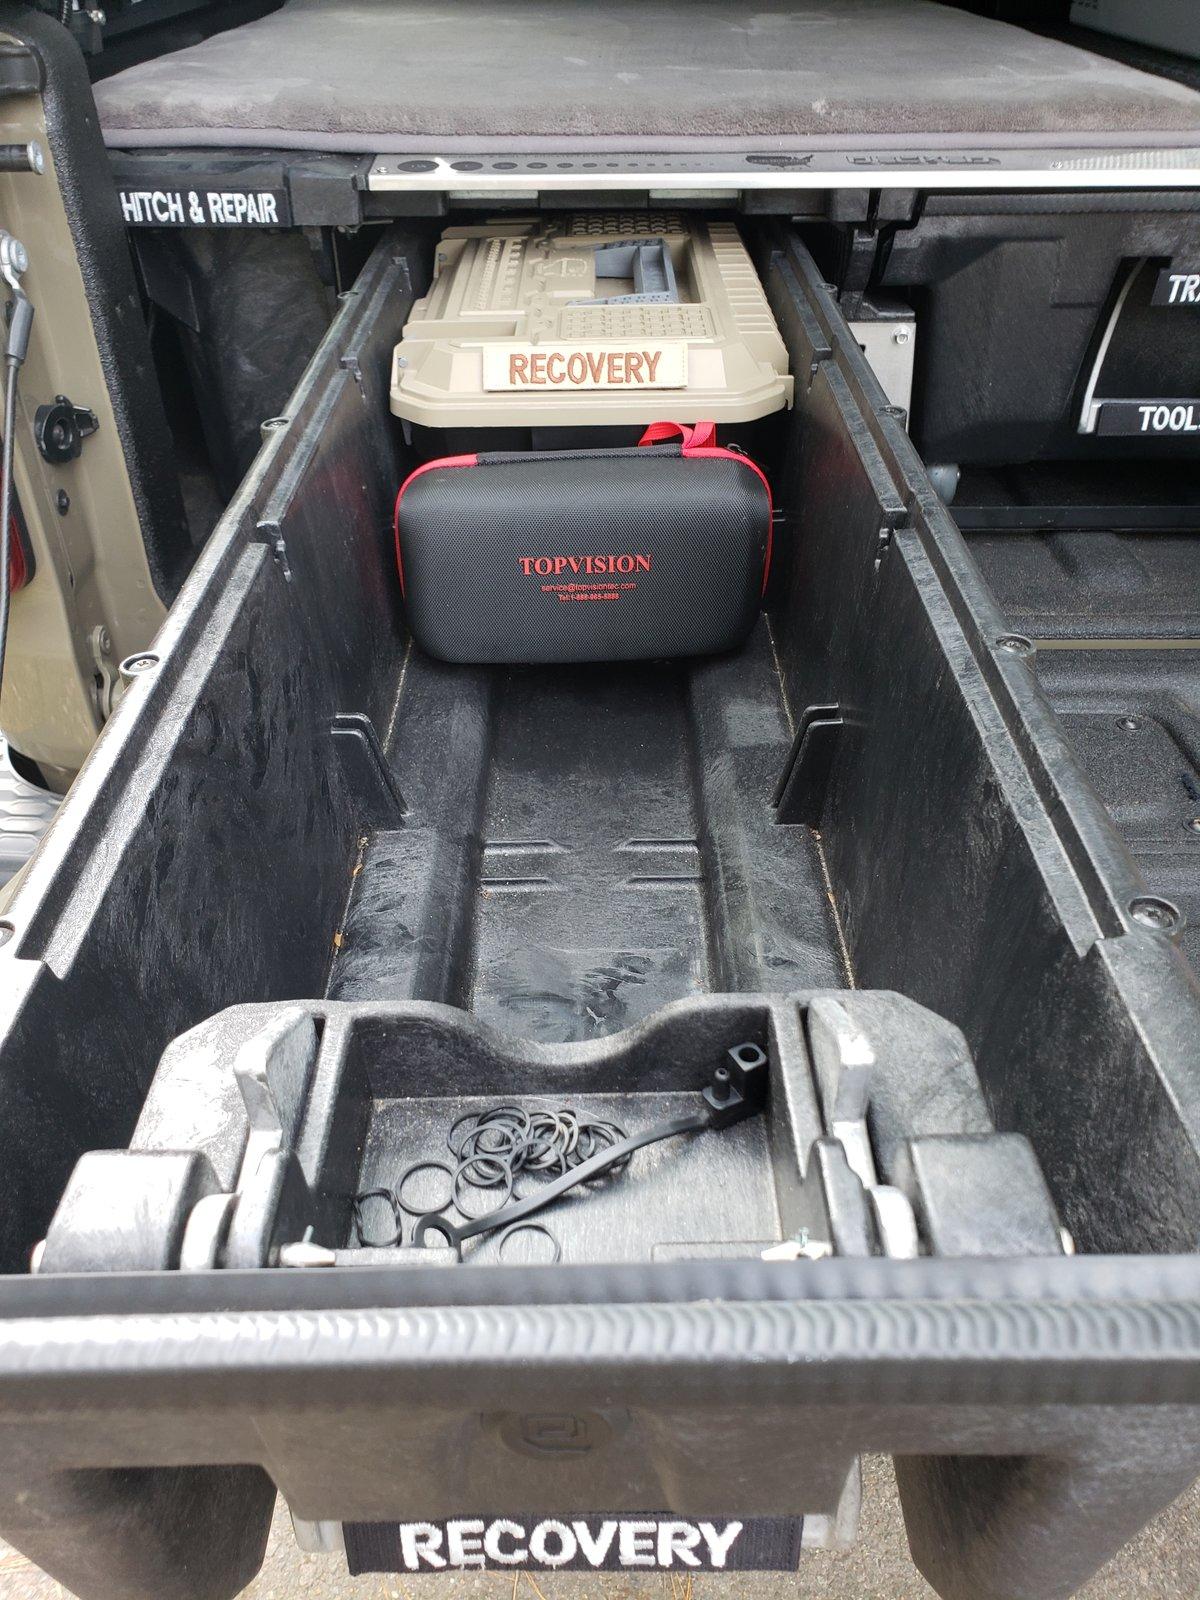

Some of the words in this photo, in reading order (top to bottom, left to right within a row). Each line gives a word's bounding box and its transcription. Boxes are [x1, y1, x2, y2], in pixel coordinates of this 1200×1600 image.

[120, 191, 185, 223] HITCH
[188, 191, 206, 223] &
[207, 192, 279, 223] REPAIR
[1168, 274, 1200, 303] TR
[509, 351, 662, 384] RECOVERY
[1138, 405, 1200, 431] TOOL
[518, 554, 652, 576] TOPVISION
[399, 1519, 743, 1570] RECOVERY
